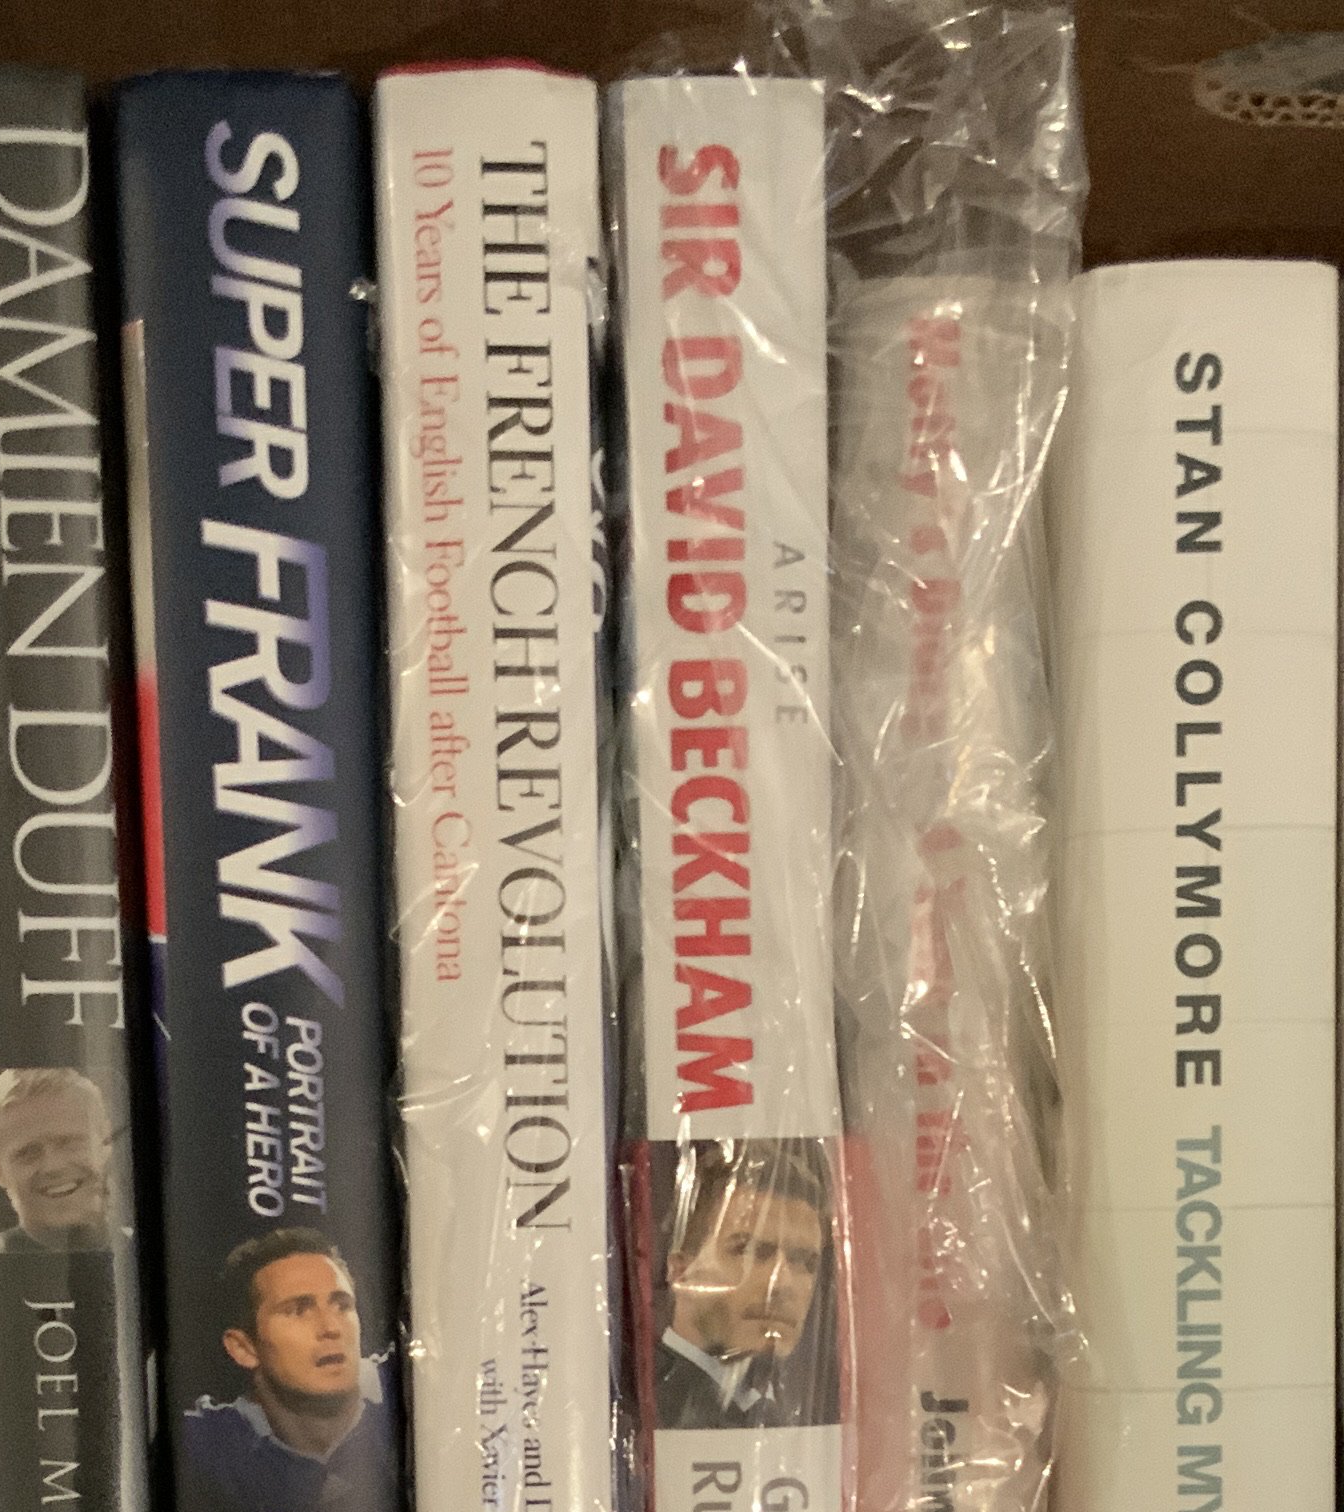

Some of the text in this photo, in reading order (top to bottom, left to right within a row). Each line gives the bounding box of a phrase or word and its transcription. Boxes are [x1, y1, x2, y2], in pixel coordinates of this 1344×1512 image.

[1174, 352, 1224, 554] STAN
[201, 119, 346, 1007] SUPER FRANK
[410, 149, 472, 982] 10 Years of English Football after Cantona
[658, 144, 754, 1114] SIR DAVID BECKHAM
[773, 541, 809, 725] ARISE
[481, 141, 572, 1233] THE FRENCH REVOLUTION
[8, 704, 126, 1030] DUFF
[1174, 600, 1224, 1087] COLLYMORE
[241, 1002, 285, 1218] OF A HERO
[287, 1015, 326, 1214] PORTRAIT
[24, 1299, 80, 1430] JOEL
[1174, 1125, 1224, 1425] TACKLING
[479, 1358, 508, 1416] with
[481, 1422, 508, 1506] Xavier
[524, 1434, 552, 1487] and
